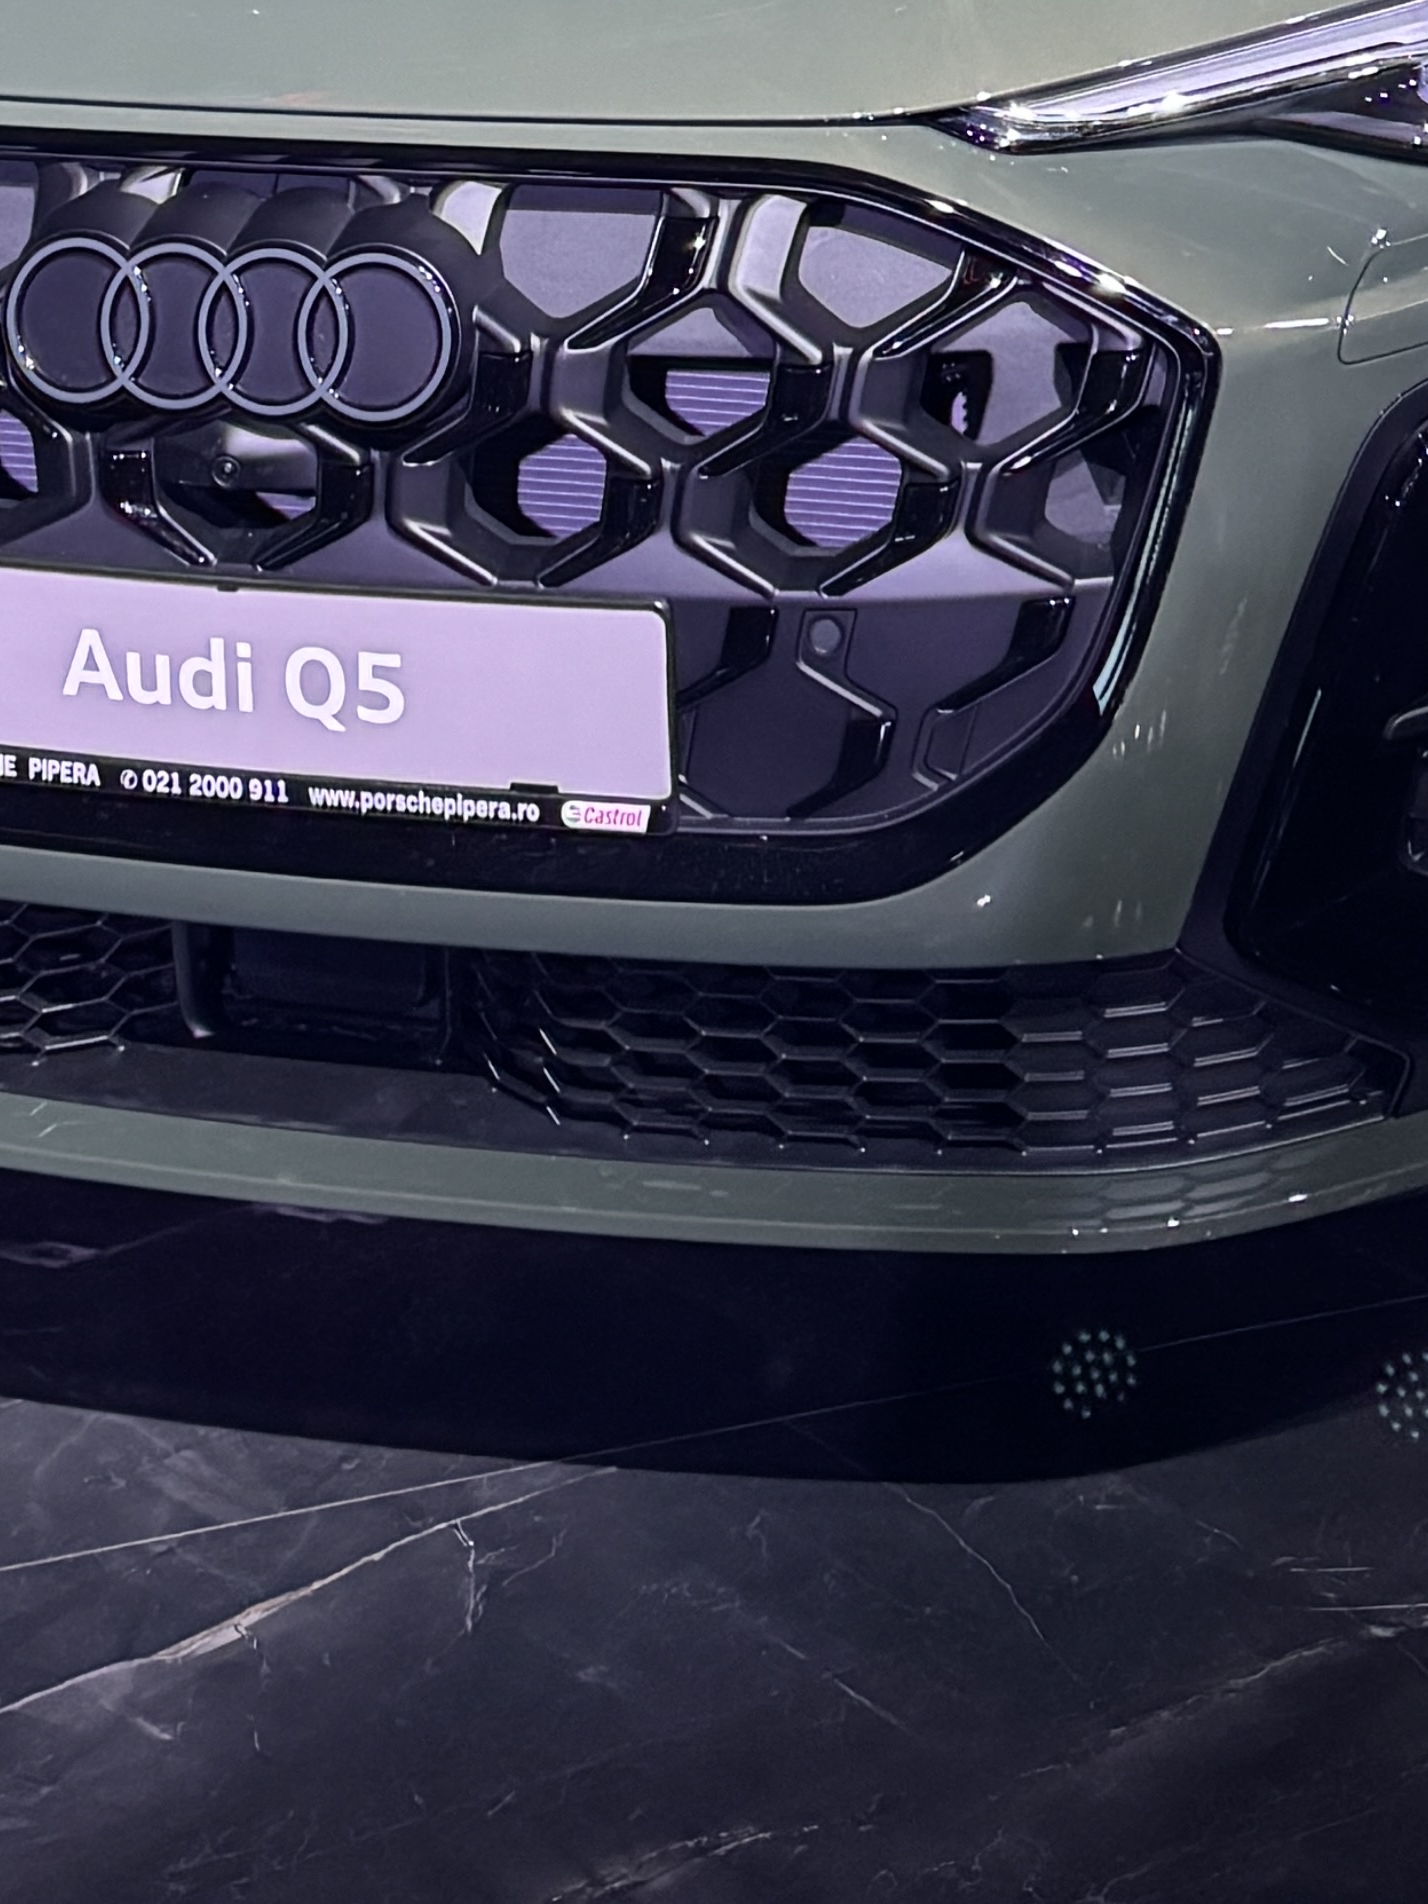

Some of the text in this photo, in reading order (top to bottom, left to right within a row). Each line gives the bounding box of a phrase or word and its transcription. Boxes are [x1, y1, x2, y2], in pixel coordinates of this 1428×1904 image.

[62, 628, 405, 732] Audi Q5
[28, 757, 101, 787] PIPERA
[141, 769, 182, 795] 021
[189, 774, 243, 800] 2000
[248, 778, 289, 803] 911
[308, 787, 541, 824] www.porschepipera.ro
[583, 806, 643, 828] Castrol
